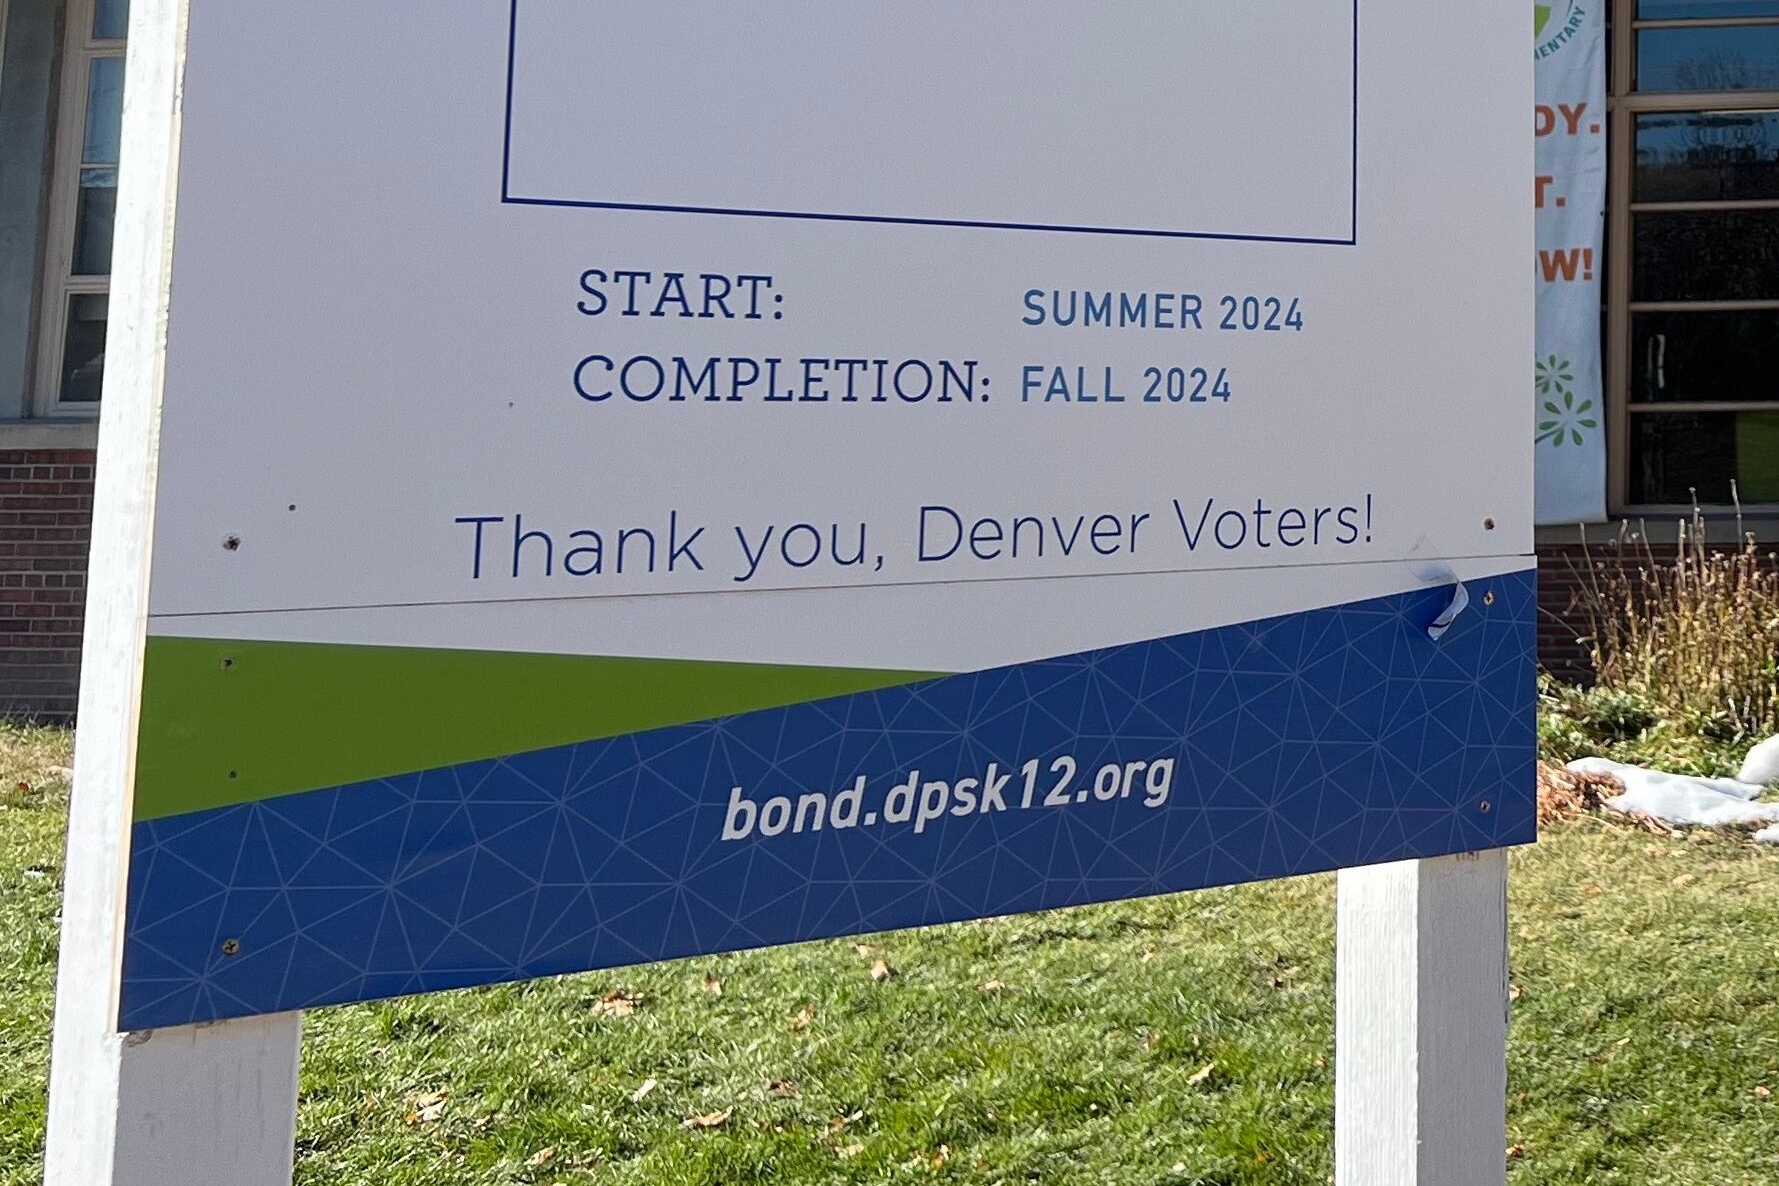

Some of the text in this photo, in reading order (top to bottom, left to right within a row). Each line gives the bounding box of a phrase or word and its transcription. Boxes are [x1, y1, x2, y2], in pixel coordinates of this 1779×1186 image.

[1535, 5, 1586, 61] ENTARY
[576, 268, 1305, 333] START: SUMMER 2024
[571, 354, 1233, 405] COMPLETION: FALL 2024
[454, 492, 1376, 584] Thank you, Denver Voters!
[719, 754, 1176, 842] bond.dpsk12.org
